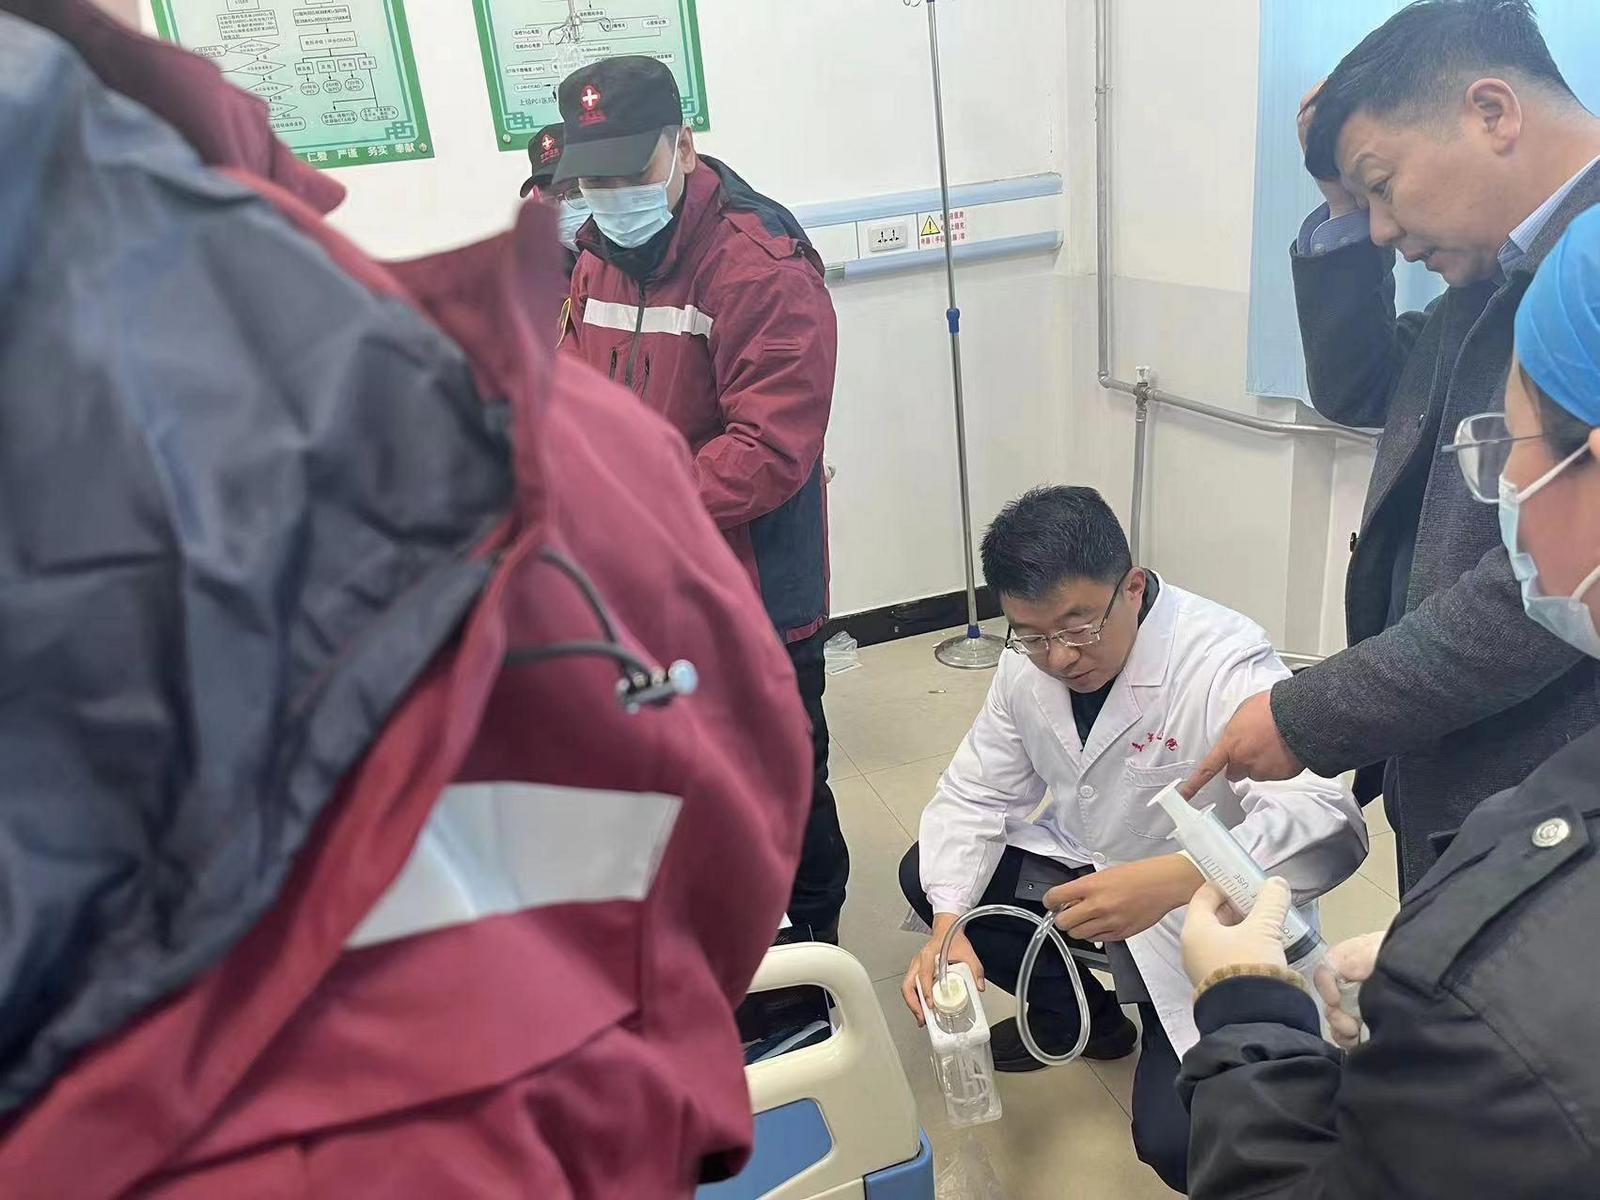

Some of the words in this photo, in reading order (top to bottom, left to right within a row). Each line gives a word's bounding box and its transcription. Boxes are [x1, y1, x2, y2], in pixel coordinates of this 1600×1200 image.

[337, 147, 359, 160] 严谨
[367, 145, 388, 157] 务实
[394, 142, 415, 154] 奉献
[1233, 873, 1249, 890] USE
